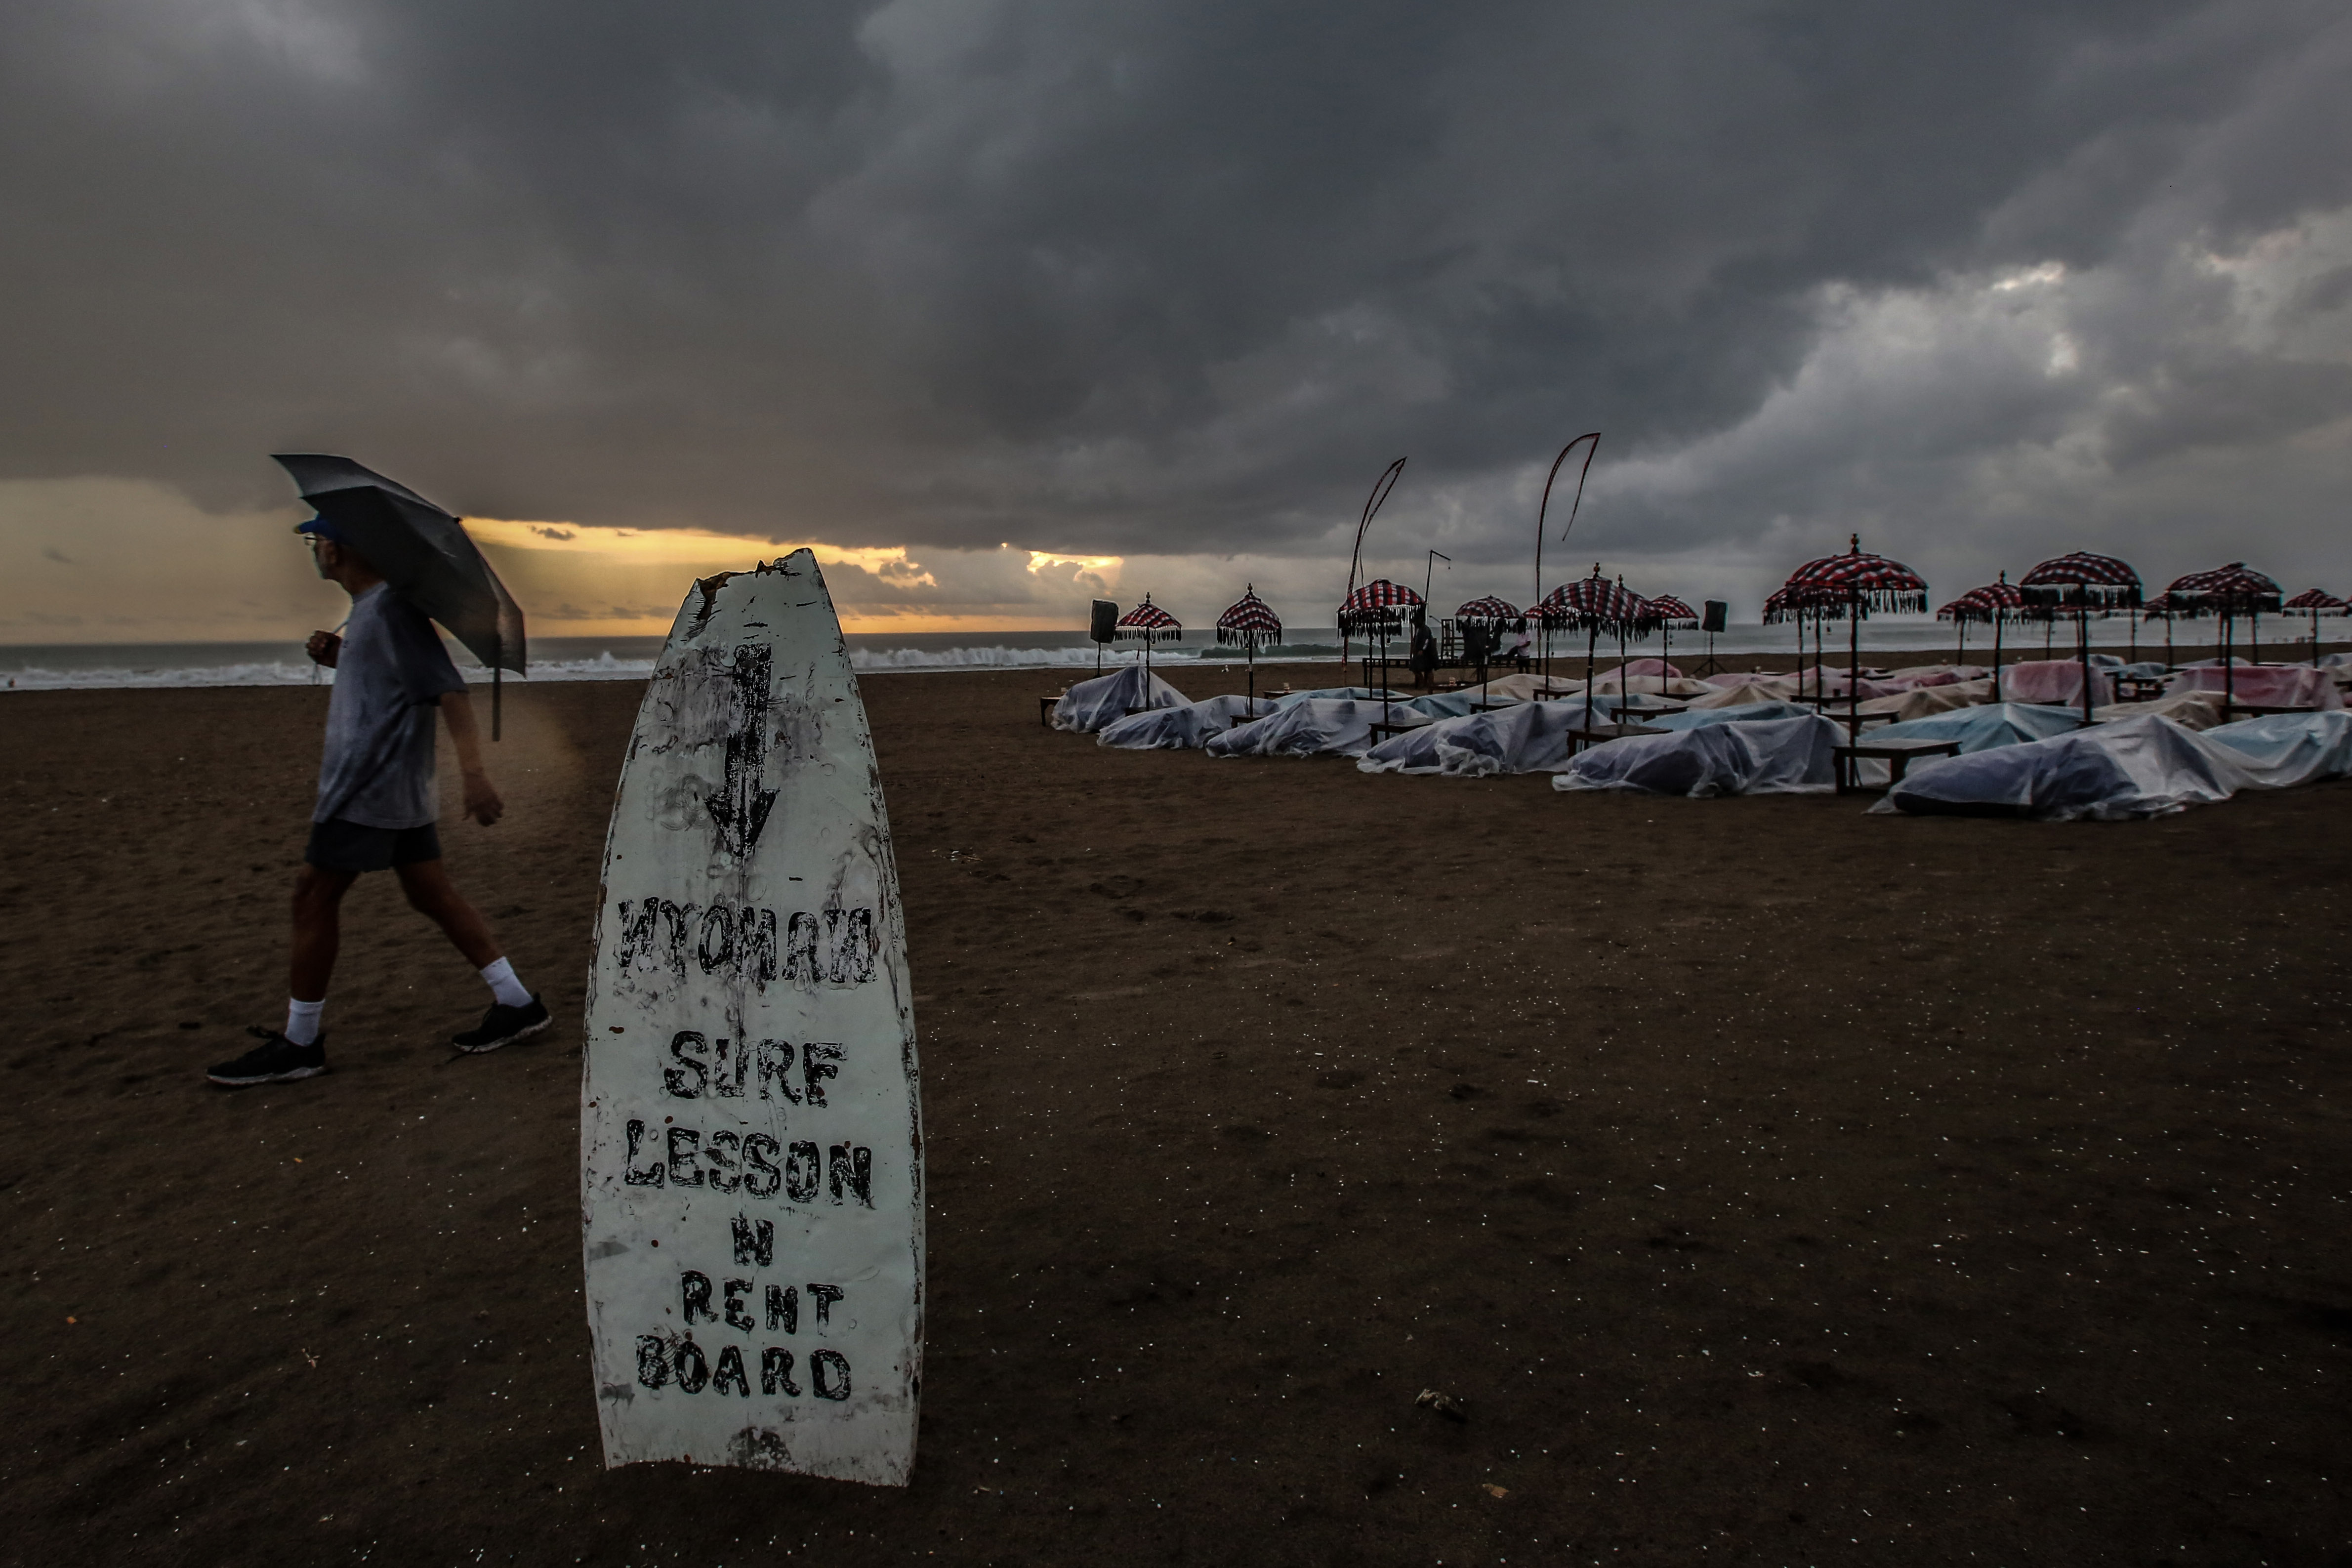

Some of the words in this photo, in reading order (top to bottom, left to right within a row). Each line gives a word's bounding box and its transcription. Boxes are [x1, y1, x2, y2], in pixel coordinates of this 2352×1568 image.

[663, 1031, 848, 1108] SURF
[624, 1119, 872, 1206] LESSON
[731, 1215, 774, 1267] N
[680, 1270, 844, 1336] RENT
[636, 1335, 851, 1401] BOARD
